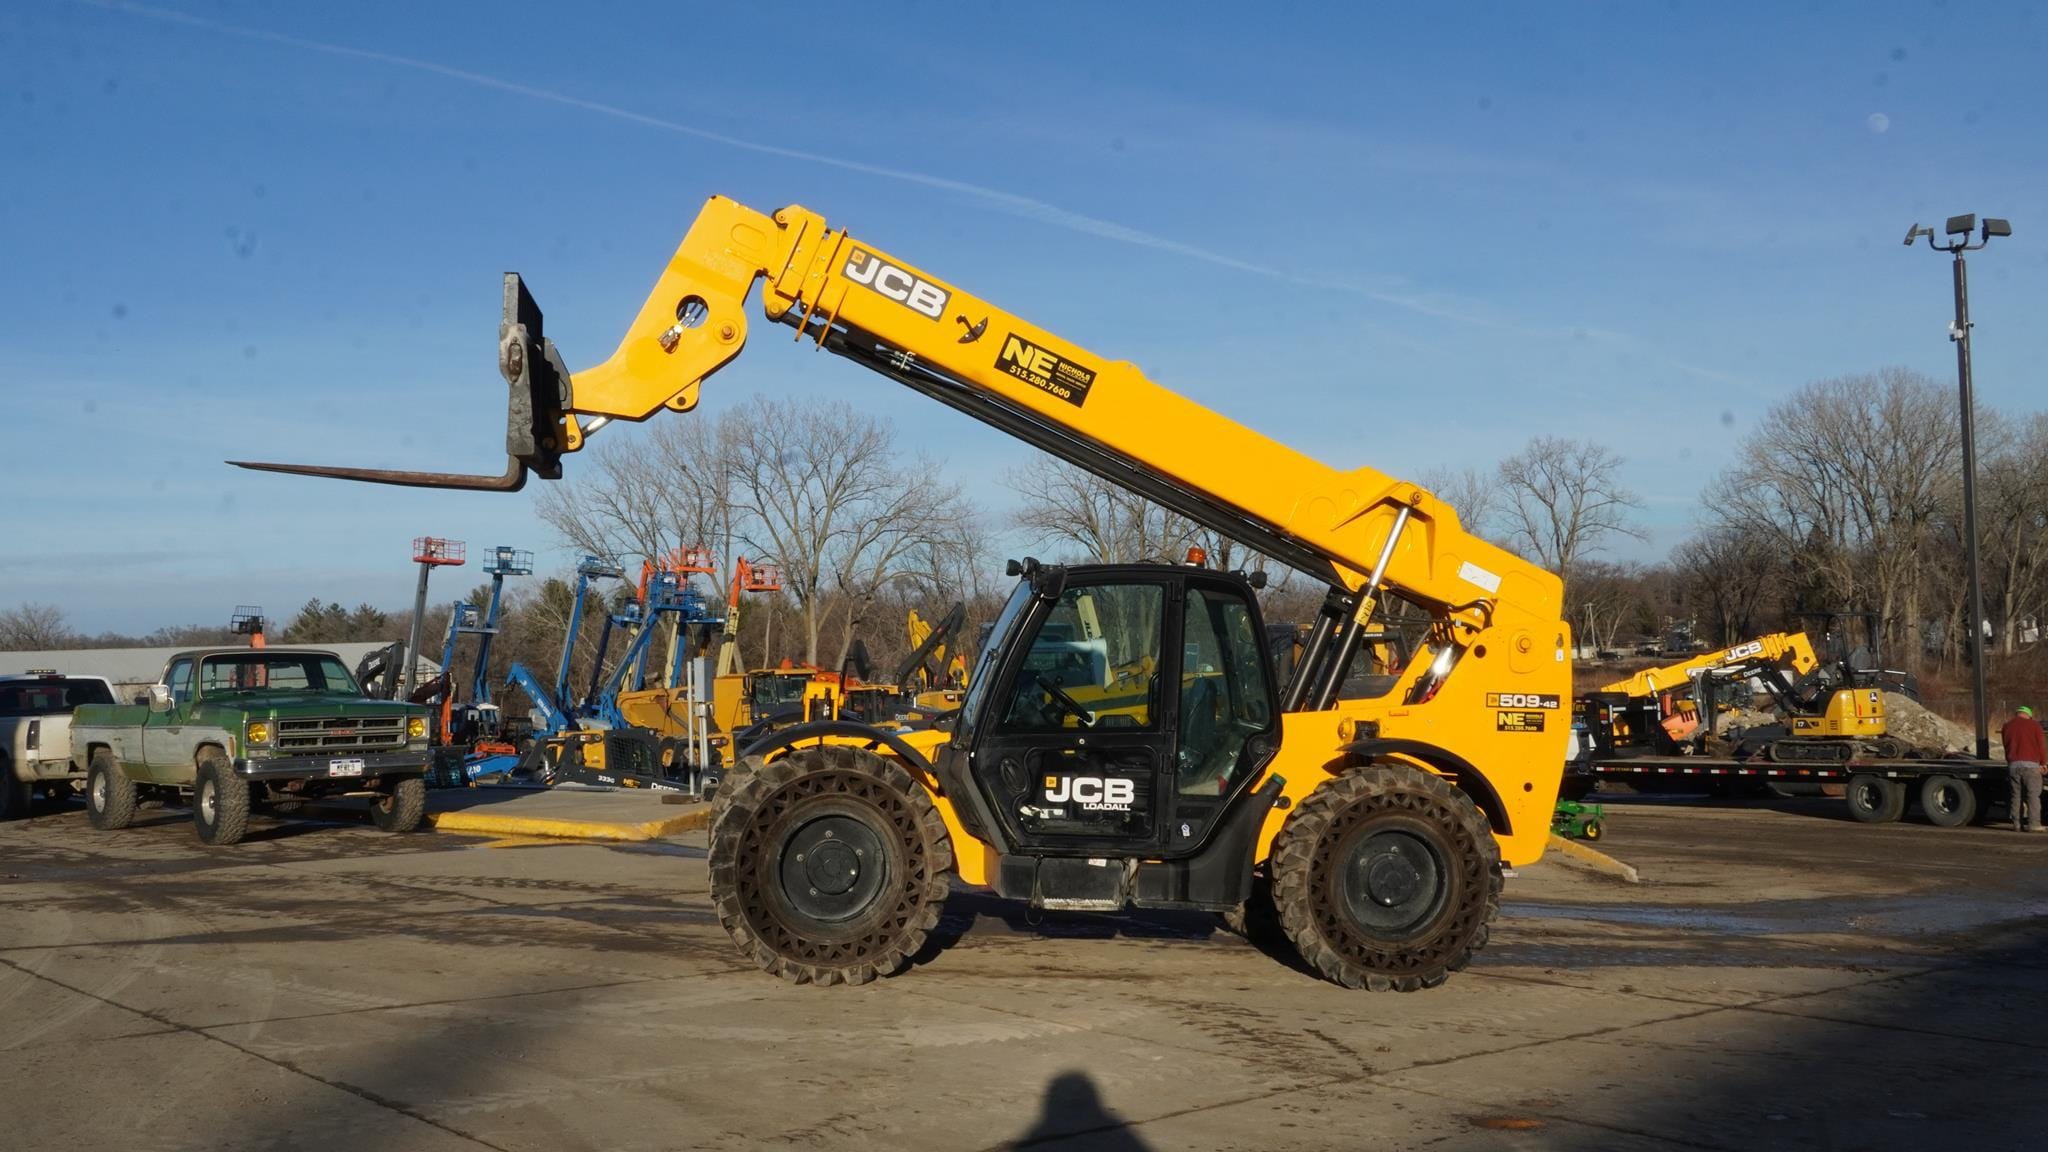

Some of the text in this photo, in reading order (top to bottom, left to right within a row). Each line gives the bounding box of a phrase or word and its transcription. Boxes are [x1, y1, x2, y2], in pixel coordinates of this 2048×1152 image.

[846, 257, 946, 317] JCB
[1002, 337, 1058, 379] NE
[1059, 362, 1091, 381] NICHOLS
[1009, 365, 1071, 399] 515.280.7600
[1726, 642, 1762, 661] JCB
[1500, 694, 1558, 709] 509-42
[1498, 712, 1526, 726] NE
[1045, 776, 1135, 805] JCB
[1083, 802, 1132, 812] LOADALL
